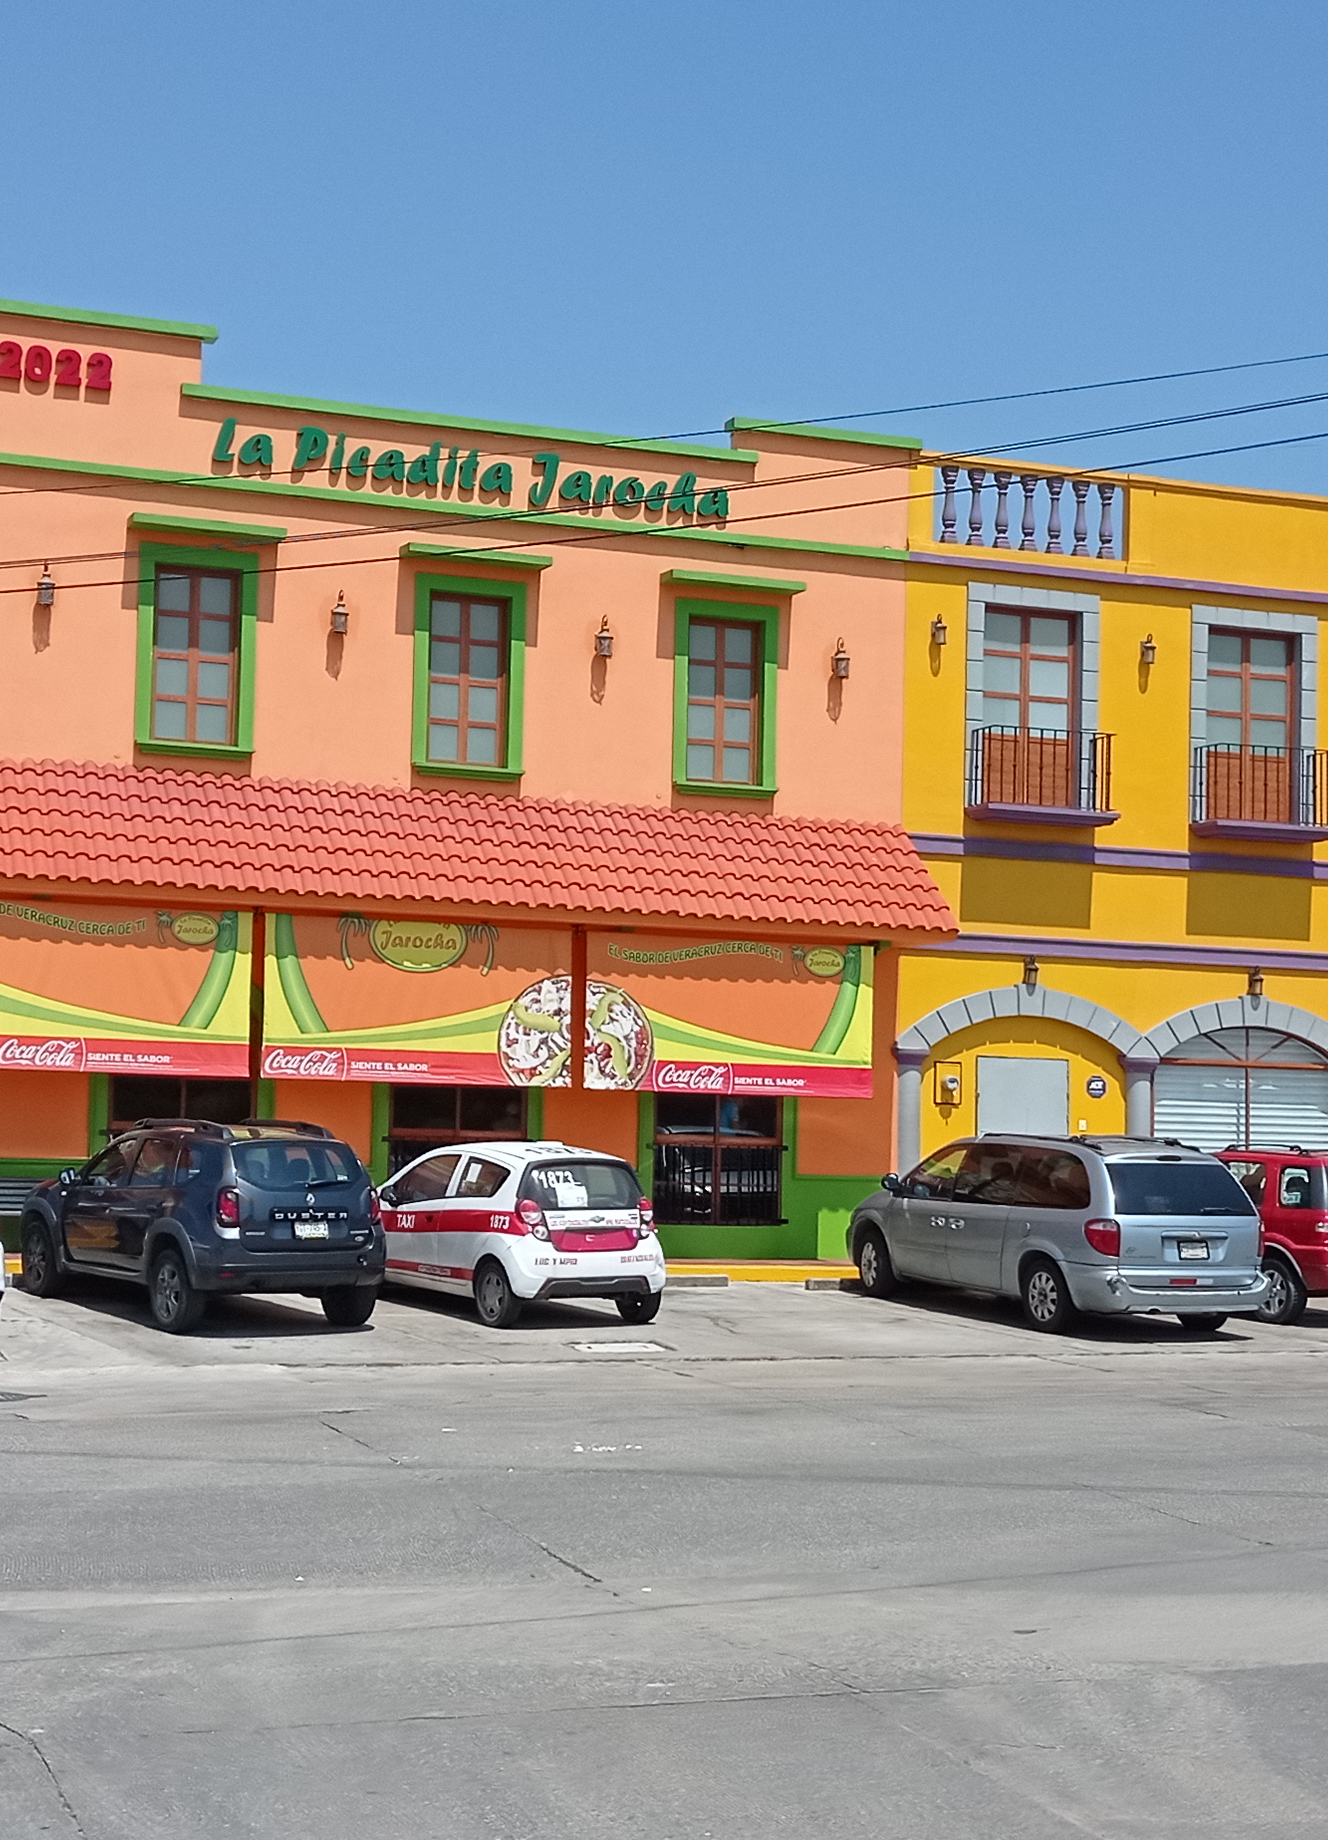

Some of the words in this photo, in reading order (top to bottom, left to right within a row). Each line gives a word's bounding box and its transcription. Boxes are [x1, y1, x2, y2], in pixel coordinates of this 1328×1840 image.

[212, 417, 274, 466] La
[292, 425, 513, 494] Picadita
[529, 452, 730, 519] Jarocha
[16, 906, 75, 931] VERACRUZ
[78, 922, 114, 936] CERCA
[117, 922, 132, 936] DE
[136, 919, 146, 931] TI
[380, 930, 457, 951] Jarocha
[608, 943, 621, 958] EL
[623, 951, 656, 963] SABOR
[657, 952, 670, 964] DE
[672, 943, 722, 963] VERACRUZ
[725, 941, 756, 955] CERCA
[758, 944, 771, 957] DE
[773, 948, 783, 963] TI
[87, 1052, 121, 1061] SIENTE
[123, 1053, 135, 1062] EL
[137, 1054, 170, 1063] SABOR
[264, 1049, 342, 1076] Coca-Cola
[350, 1061, 382, 1070] SIENTE
[384, 1062, 395, 1071] EL
[397, 1063, 428, 1072] SABOR
[658, 1064, 728, 1090] Coca-Cola
[734, 1076, 763, 1085] SIENTE
[764, 1077, 775, 1086] EL
[776, 1077, 805, 1087] SABOR
[538, 1169, 574, 1189] 1873
[396, 1214, 416, 1229] TAXI
[489, 1214, 510, 1230] 1873
